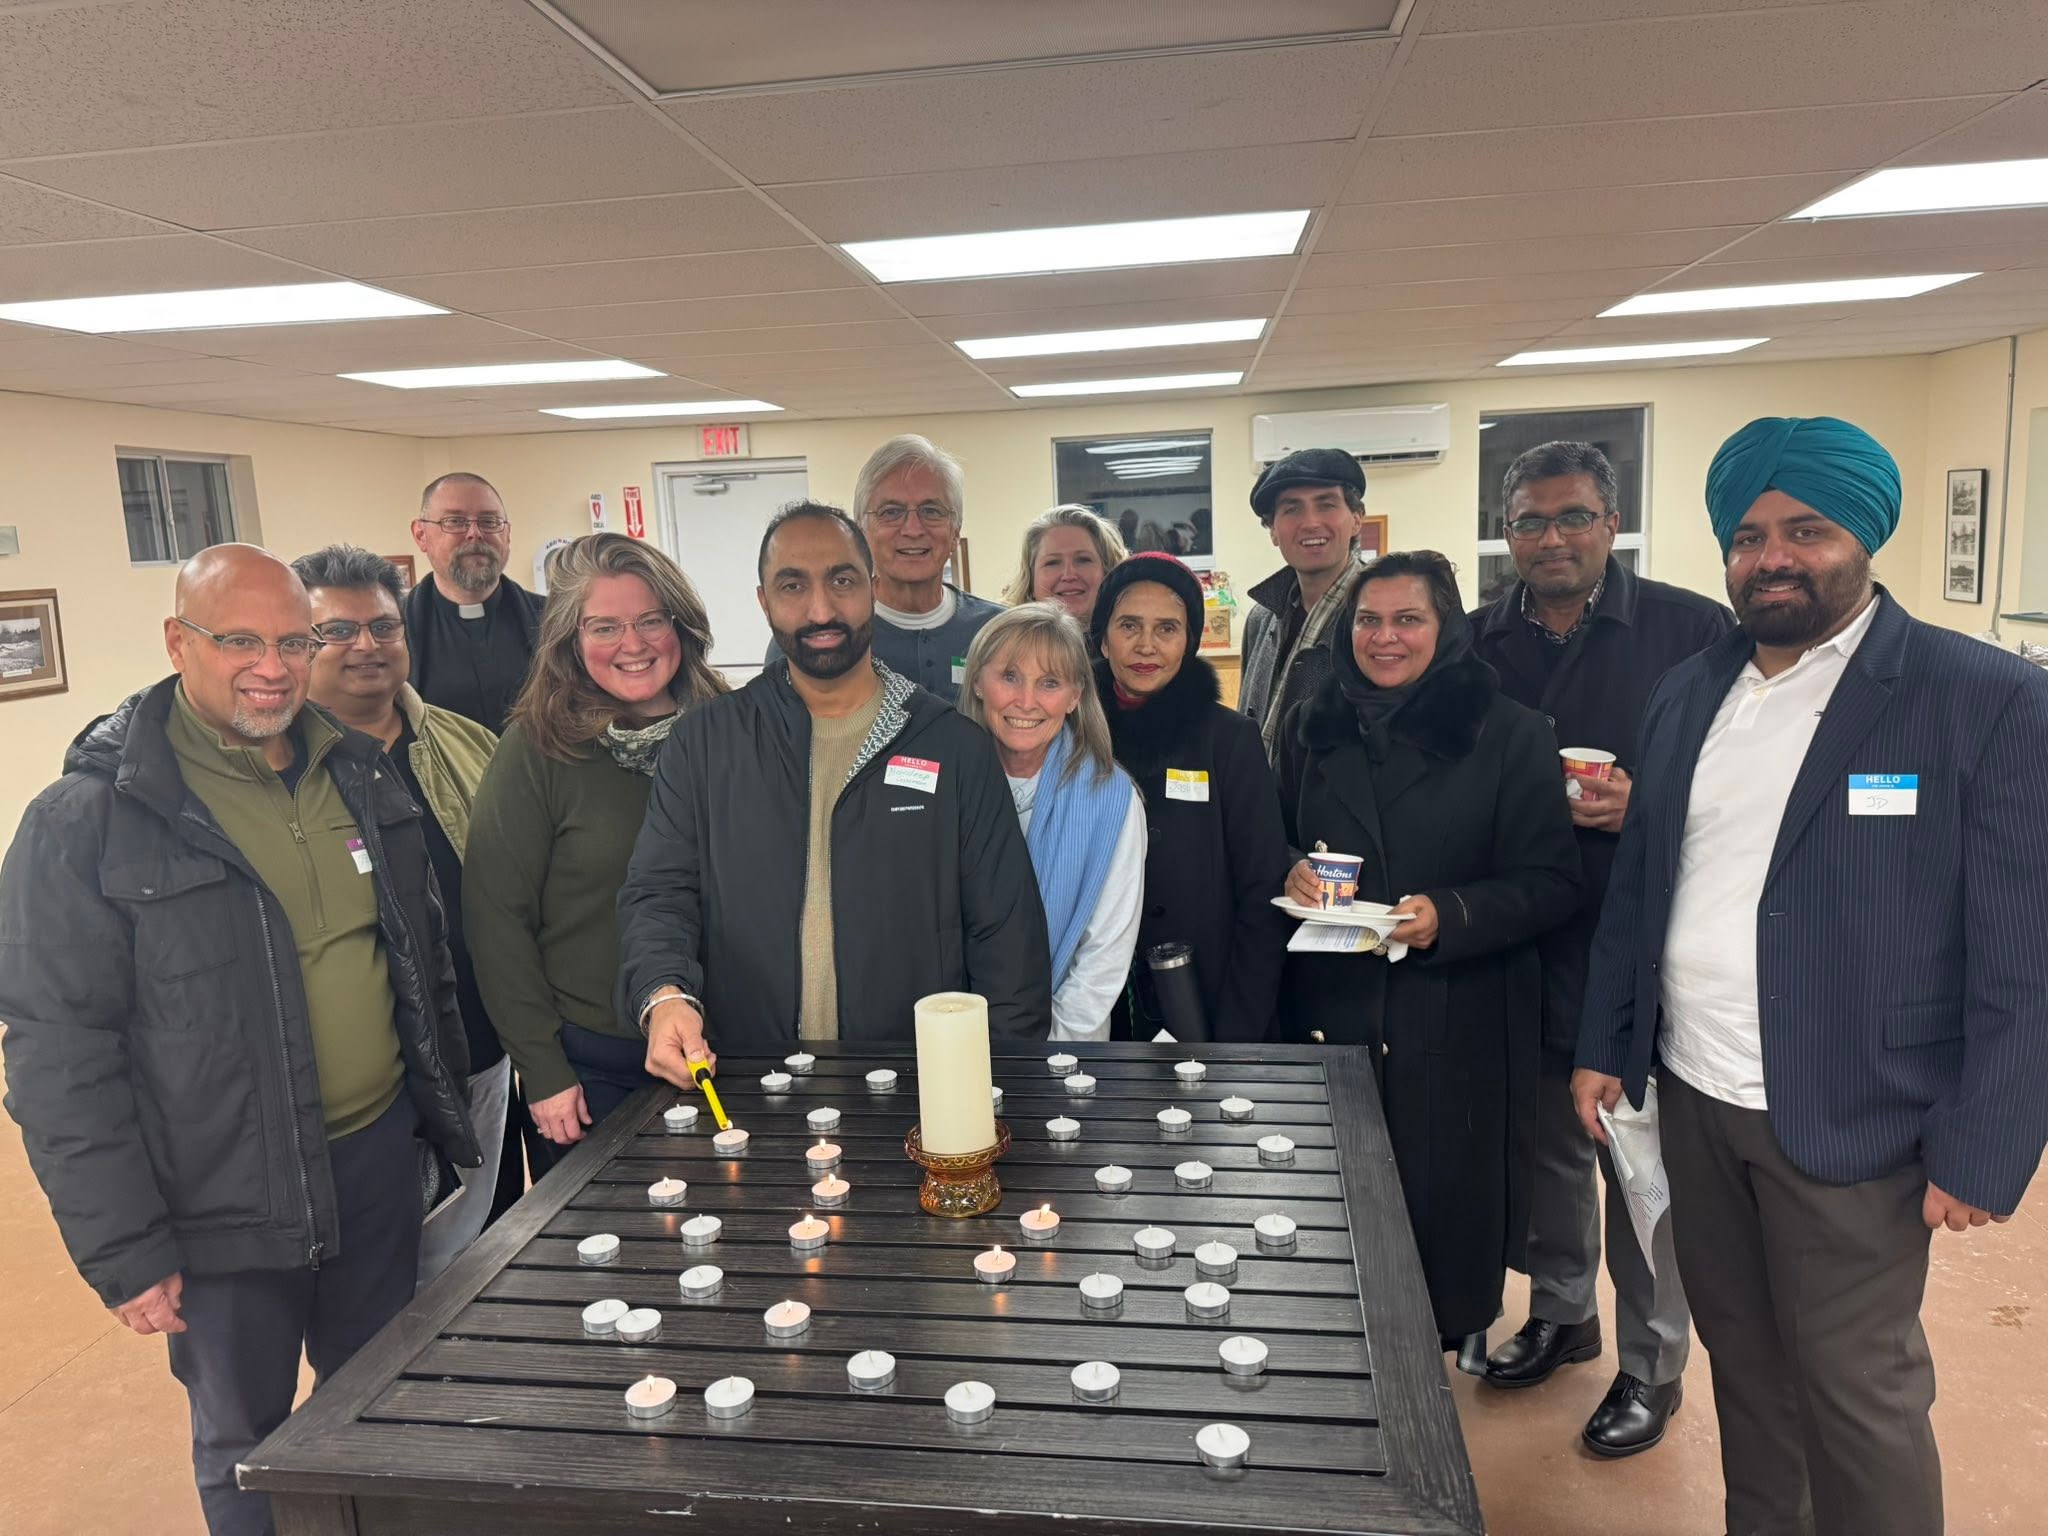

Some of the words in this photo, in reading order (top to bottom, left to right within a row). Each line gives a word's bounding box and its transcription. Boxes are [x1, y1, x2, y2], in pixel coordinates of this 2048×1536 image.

[703, 426, 740, 456] EXIT
[626, 491, 638, 499] FIRE
[900, 756, 927, 767] HELLO
[1865, 775, 1901, 784] HELLO
[1865, 796, 1888, 810] JD
[1316, 864, 1352, 879] Hortons
